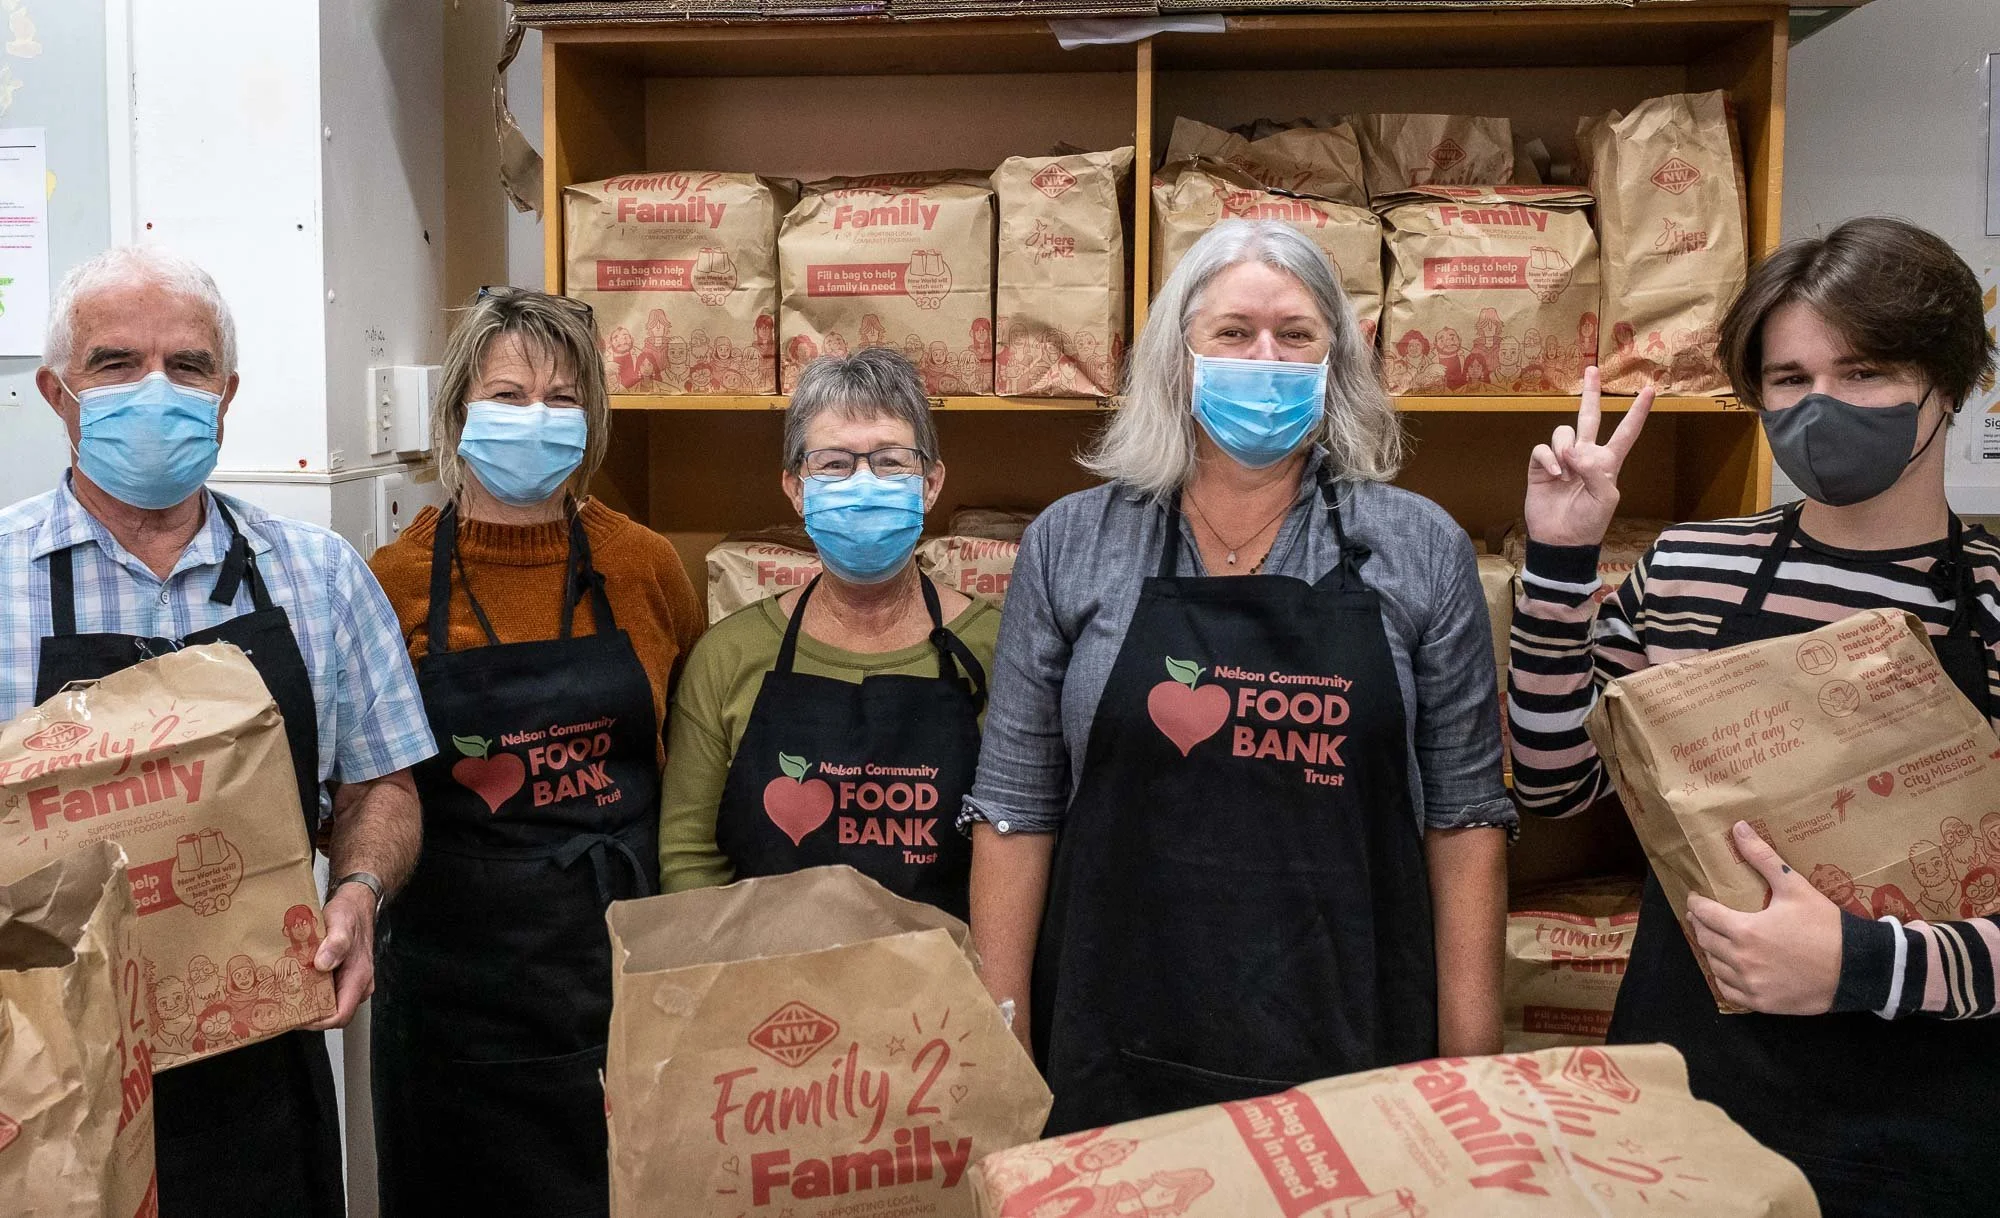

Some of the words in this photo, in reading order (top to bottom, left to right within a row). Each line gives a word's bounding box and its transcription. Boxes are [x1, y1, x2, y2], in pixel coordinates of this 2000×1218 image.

[696, 172, 722, 192] 2
[1041, 175, 1065, 186] NW
[1663, 170, 1689, 182] NW
[617, 196, 727, 229] Family
[833, 198, 940, 231] Family
[1439, 203, 1549, 232] Family
[1044, 233, 1075, 246] Here
[1674, 230, 1707, 243] Here
[1054, 246, 1074, 258] NZ
[606, 266, 621, 275] Fill
[631, 266, 650, 277] bag
[652, 266, 663, 275] to
[664, 265, 685, 277] help
[817, 271, 832, 280] Fill
[842, 270, 860, 281] bag
[862, 271, 873, 279] to
[875, 269, 897, 280] help
[1434, 263, 1450, 273] Fill
[1461, 262, 1480, 273] bag
[1483, 263, 1493, 272] to
[1495, 262, 1518, 274] help
[1436, 277, 1443, 285] a
[1445, 275, 1477, 286] family
[1479, 275, 1489, 284] in
[1491, 274, 1517, 284] need
[616, 277, 648, 288] family
[649, 277, 658, 287] in
[660, 277, 683, 287] need
[827, 282, 858, 293] family
[860, 282, 869, 291] in
[871, 282, 896, 291] need
[701, 294, 726, 306] $20
[916, 297, 940, 309] $20
[1537, 291, 1560, 304] $20
[1836, 629, 1859, 641] New
[1859, 618, 1887, 634] World
[1842, 636, 1874, 652] match
[1874, 623, 1895, 641] each
[1847, 652, 1867, 662] bag
[1214, 665, 1265, 682] Nelson
[1268, 671, 1352, 692] Community
[1631, 673, 1664, 690] canned
[1637, 690, 1654, 703] and
[1655, 679, 1686, 695] coffee,
[1686, 672, 1703, 683] rice
[1704, 663, 1721, 675] and
[1722, 652, 1750, 669] pasta,
[1750, 648, 1760, 656] to
[1644, 694, 1683, 715] non-food
[1684, 682, 1709, 698] items
[1709, 672, 1732, 687] such
[1732, 669, 1744, 678] as
[1744, 658, 1769, 673] soap,
[1858, 670, 1876, 680] We
[1865, 672, 1903, 692] directly
[1903, 667, 1914, 676] to
[1649, 702, 1697, 728] toothpaste
[1697, 692, 1715, 706] and
[1717, 679, 1759, 700] shampoo.
[1870, 685, 1895, 702] local
[1236, 687, 1350, 726] FOOD
[41, 728, 77, 746] NW
[500, 729, 547, 747] Nelson
[549, 716, 617, 737] Community
[1671, 736, 1709, 762] Please
[1712, 721, 1741, 743] drop
[1743, 707, 1762, 729] off
[1764, 700, 1794, 727] your
[0, 732, 134, 785] Family
[148, 714, 180, 753] 2
[528, 732, 611, 777] FOOD
[1232, 725, 1348, 767] BANK
[1688, 742, 1742, 774] donation
[1744, 731, 1758, 748] at
[1761, 724, 1785, 741] any
[1897, 738, 1977, 775] Christchurch
[819, 761, 862, 776] Nelson
[865, 763, 939, 779] Community
[1704, 768, 1729, 789] New
[1729, 747, 1767, 775] World
[1769, 737, 1804, 758] store.
[1903, 773, 1931, 788] City
[1930, 754, 1977, 779] Mission
[532, 760, 615, 808] BANK
[1303, 768, 1345, 787] Trust
[27, 757, 205, 832] Family
[595, 788, 622, 807] Trust
[839, 782, 939, 812] FOOD
[88, 816, 144, 836] SUPPORTING
[144, 809, 173, 822] LOCAL
[134, 815, 186, 834] FOODBANKS
[838, 816, 938, 846] BANK
[1783, 810, 1832, 834] wellington
[1787, 820, 1837, 843] citymission
[902, 850, 938, 864] Trust
[178, 876, 195, 886] New
[197, 867, 221, 878] World
[222, 862, 236, 872] will
[185, 879, 211, 893] match
[212, 873, 232, 884] each
[193, 889, 208, 899] bag
[208, 883, 228, 895] with
[194, 893, 231, 917] $20
[770, 1020, 820, 1044] NW
[1578, 1024, 1588, 1032] in
[711, 1041, 890, 1146] Family
[906, 1037, 951, 1117] 2
[1276, 1102, 1306, 1136] bag
[1263, 1136, 1285, 1158] in
[1295, 1133, 1316, 1153] to
[750, 1125, 973, 1207] Family
[1272, 1155, 1314, 1198] need
[1305, 1150, 1340, 1190] help
[816, 1199, 886, 1218] SUPPORTING
[887, 1194, 922, 1207] LOCAL
